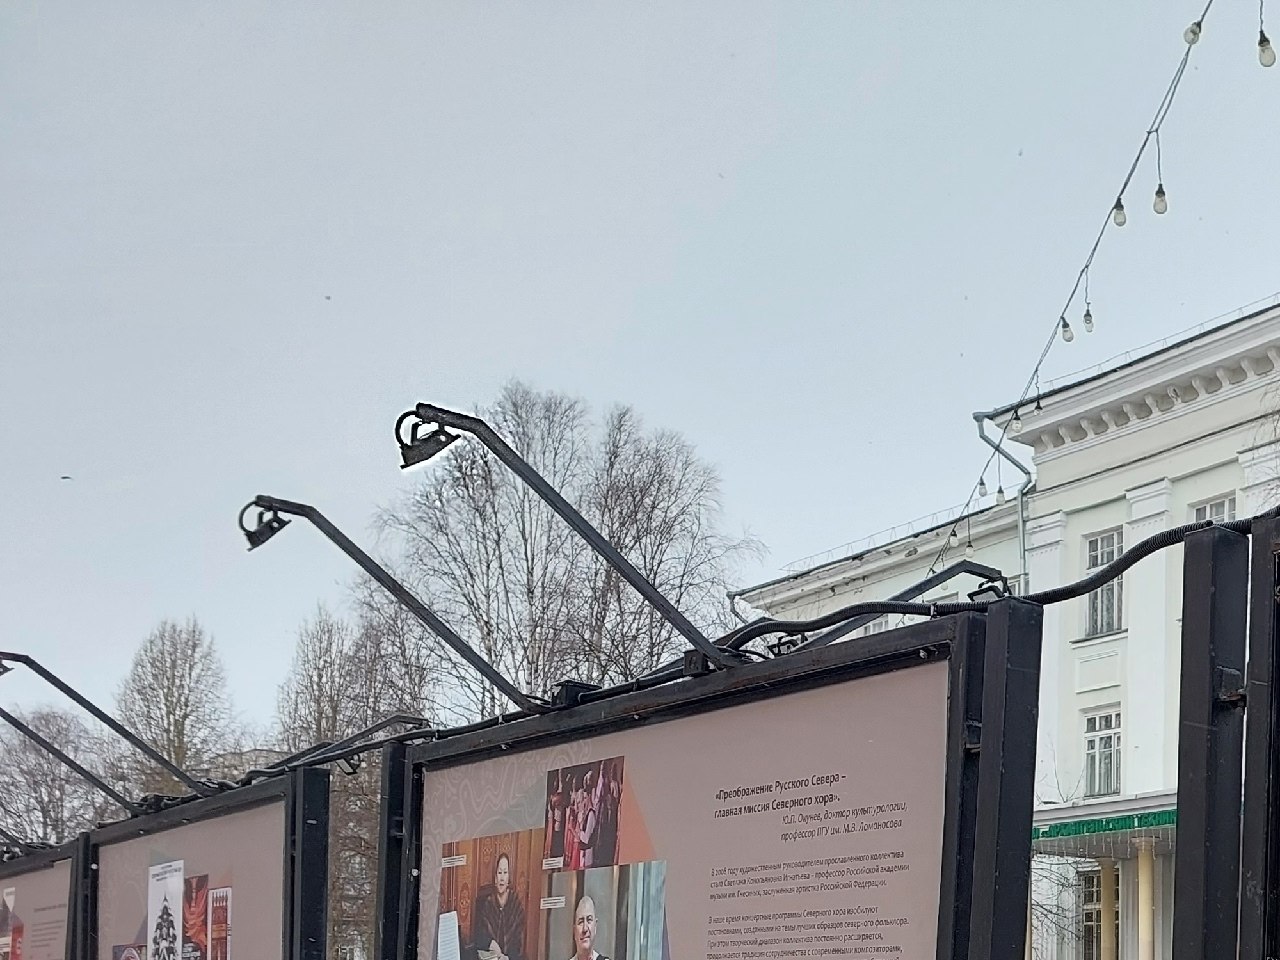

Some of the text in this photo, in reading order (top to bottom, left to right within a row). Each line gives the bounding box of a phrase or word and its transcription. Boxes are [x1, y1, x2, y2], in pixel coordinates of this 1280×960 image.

[715, 784, 773, 801] «Преображение
[774, 779, 809, 793] Русского
[811, 775, 839, 786] Севера
[714, 807, 742, 818] главная
[744, 803, 770, 814] миссия
[771, 798, 812, 810] Северного
[824, 810, 851, 819] доктор
[780, 830, 815, 842] профессор
[859, 820, 902, 831] Ломоносова
